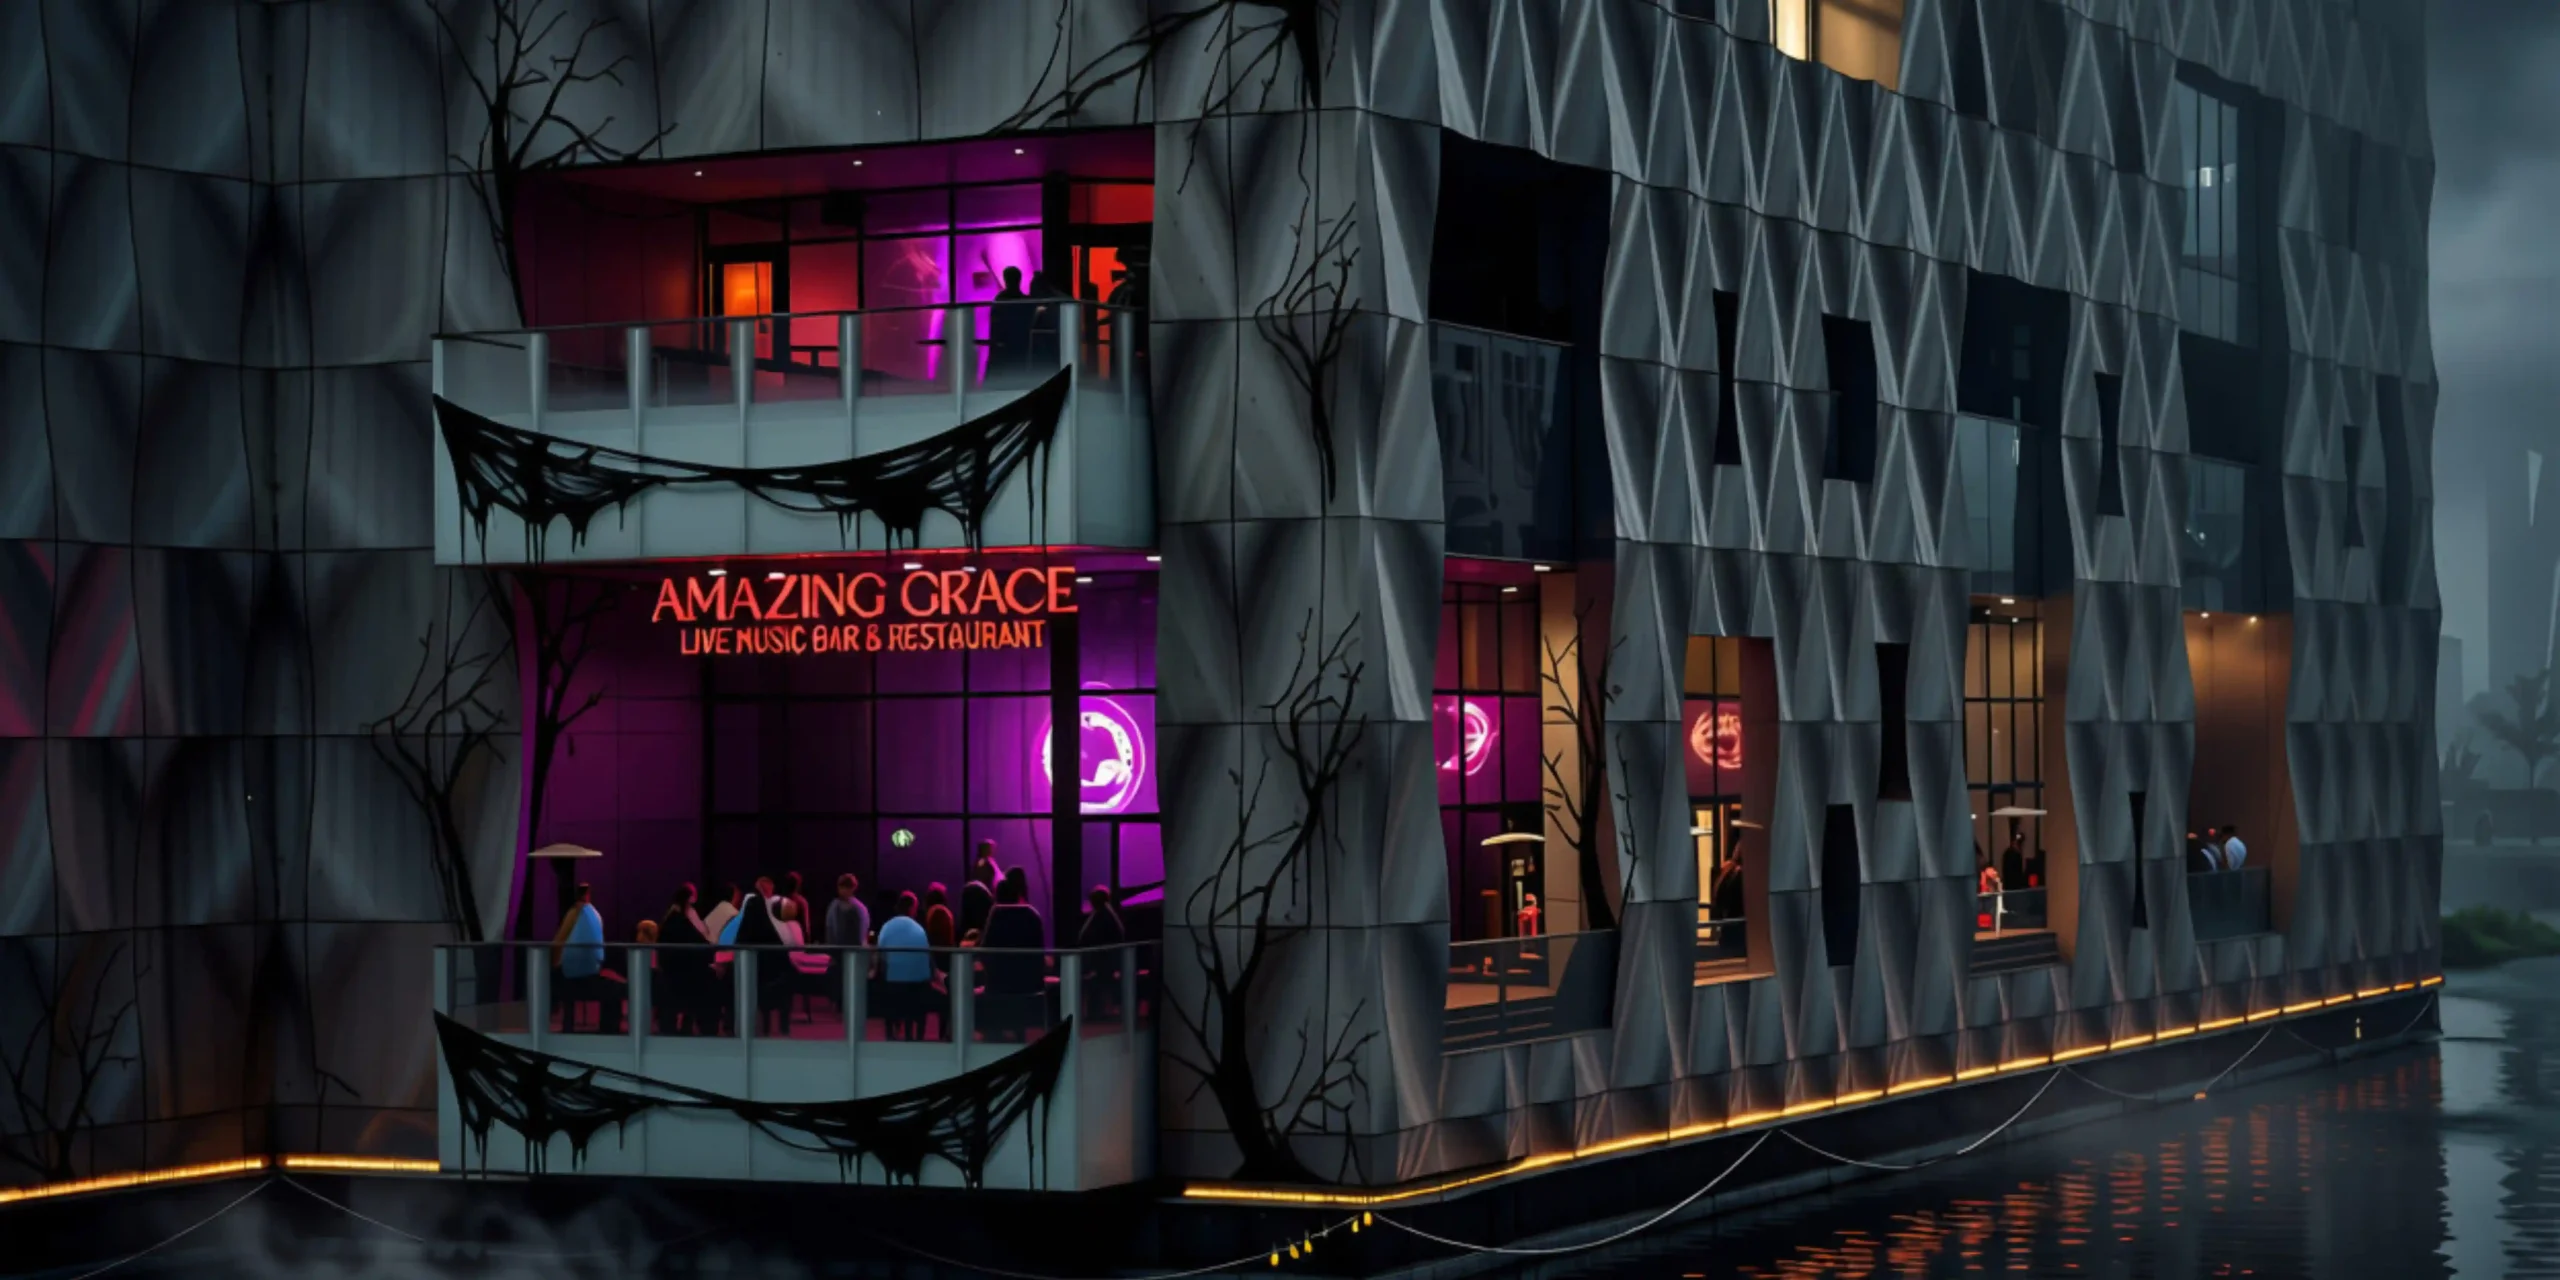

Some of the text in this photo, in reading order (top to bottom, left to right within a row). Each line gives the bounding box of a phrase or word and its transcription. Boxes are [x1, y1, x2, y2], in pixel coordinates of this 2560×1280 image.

[652, 566, 1079, 622] AMAZING GRACE
[680, 626, 733, 654] LIVE
[812, 624, 860, 652] BAR
[865, 623, 882, 651] &
[888, 619, 1046, 651] RESTAURANT
